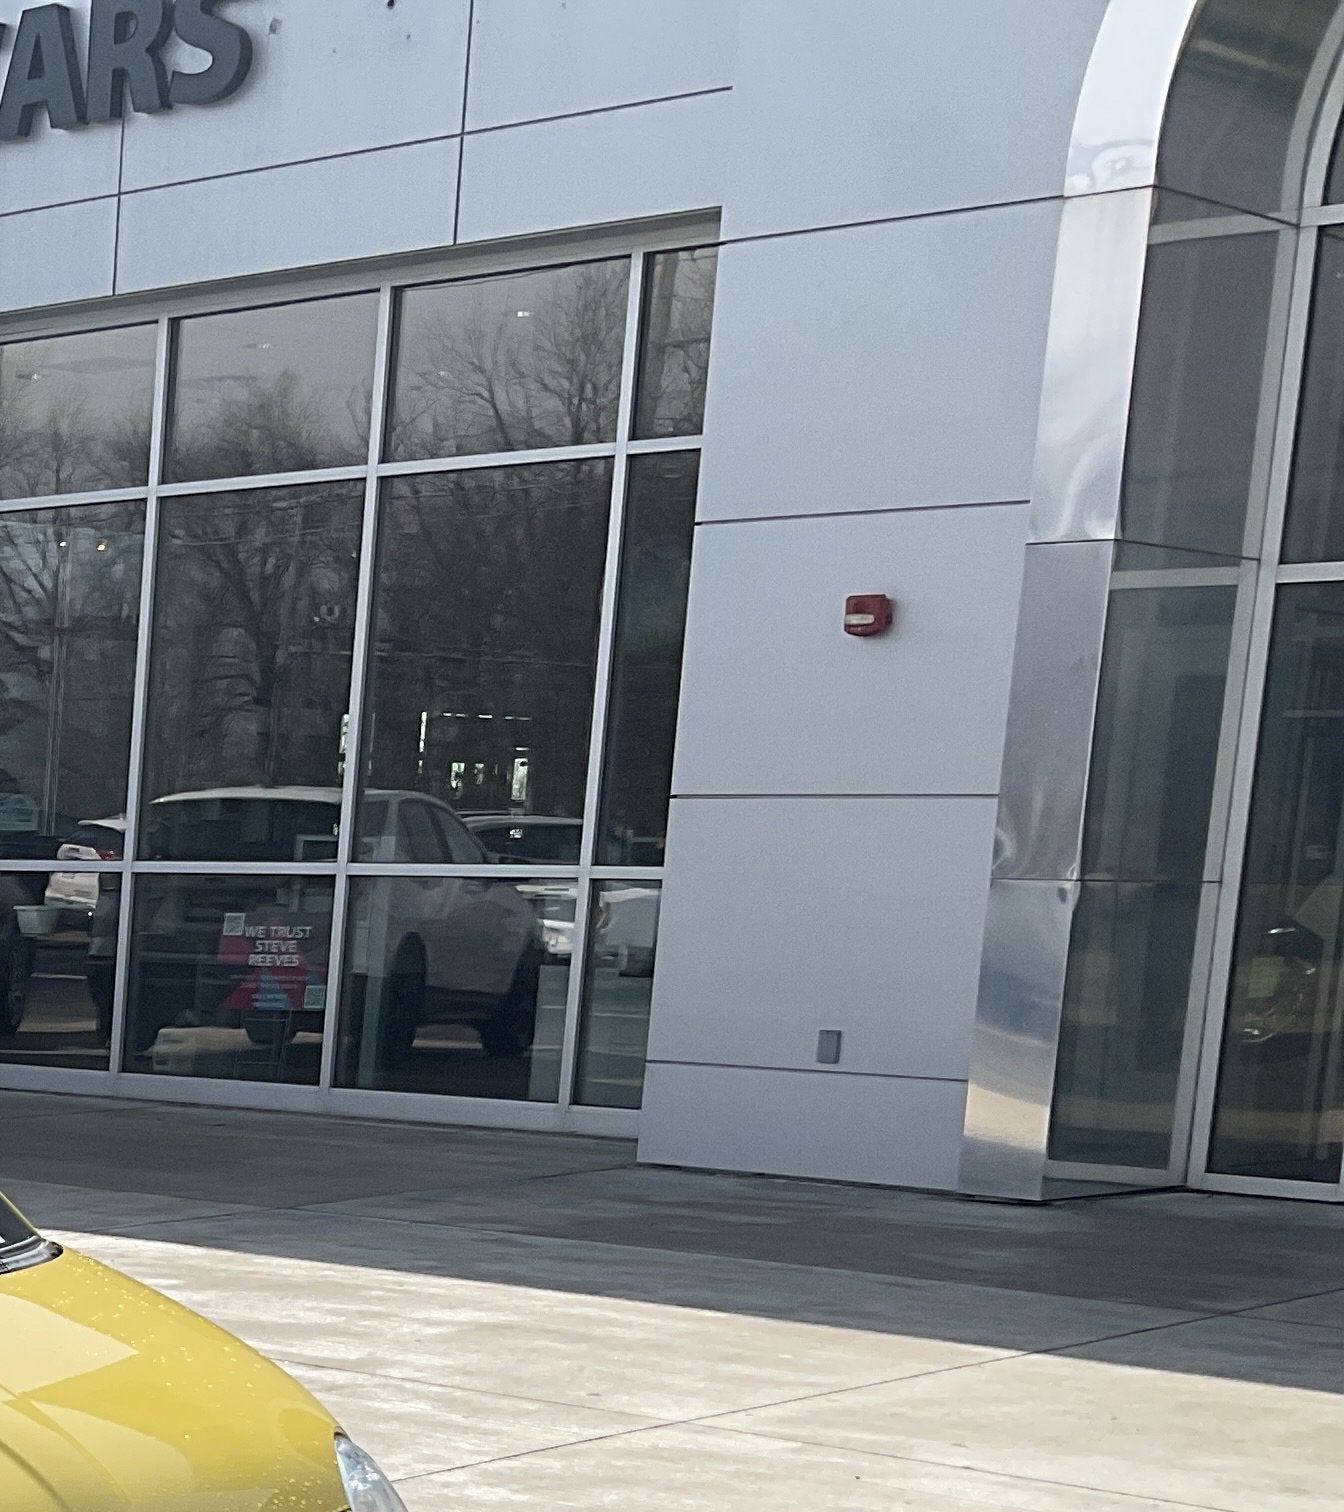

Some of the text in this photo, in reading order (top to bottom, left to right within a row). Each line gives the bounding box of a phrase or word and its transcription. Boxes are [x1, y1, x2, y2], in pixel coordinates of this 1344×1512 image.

[244, 926, 312, 937] WE TRUST
[254, 940, 298, 952] STEVE
[248, 954, 300, 966] REEVES
